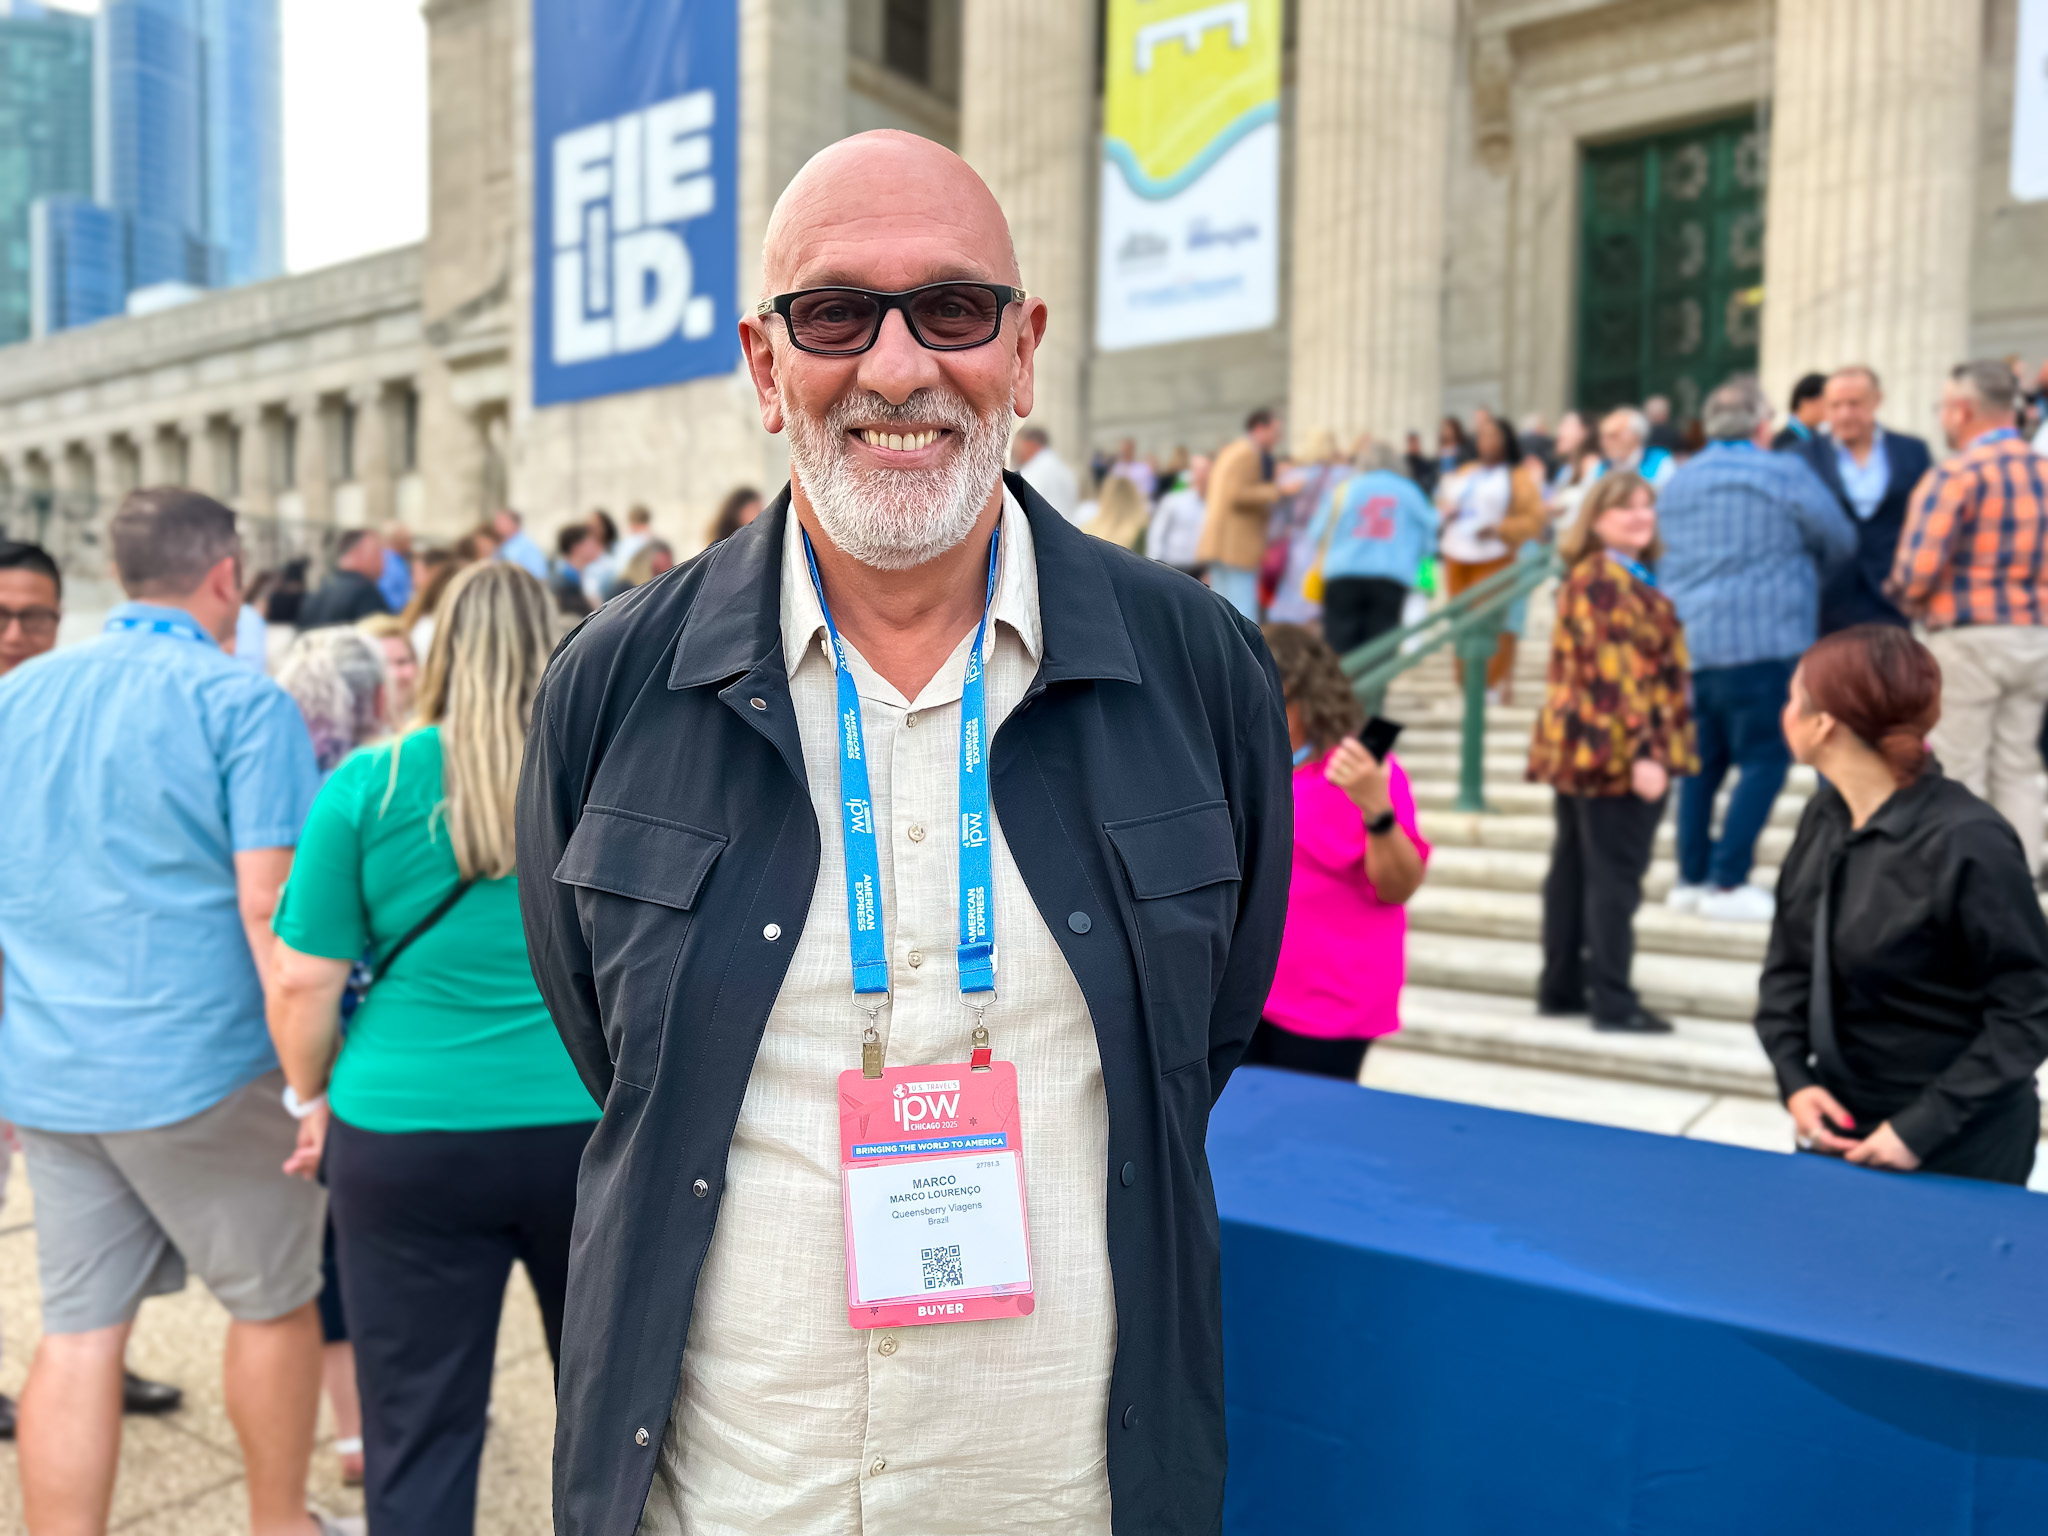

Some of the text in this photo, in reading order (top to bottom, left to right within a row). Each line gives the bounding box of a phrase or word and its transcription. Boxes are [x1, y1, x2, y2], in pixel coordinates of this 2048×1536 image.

[843, 713, 855, 760] EXPRESS
[849, 707, 861, 760] AMERICAN
[972, 717, 981, 764] EXPRESS
[966, 720, 974, 773] AMERICAN
[855, 881, 867, 931] EXPRESS
[863, 873, 875, 930] AMERICAN
[976, 886, 986, 936] EXPRESS
[967, 888, 977, 943] AMERICAN
[926, 1081, 958, 1090] TRAVEL'S
[910, 1121, 958, 1131] CHICAGO 2025
[855, 1137, 1004, 1155] BRINGING THE WORLD TO AMERICA
[976, 1160, 1000, 1169] 27781.3
[912, 1175, 957, 1189] MARCO
[889, 1185, 981, 1204] MARCO LOURENÇO
[891, 1202, 983, 1219] Queensberry Viagens
[927, 1216, 949, 1225] Brazil
[917, 1303, 964, 1317] BUYER
